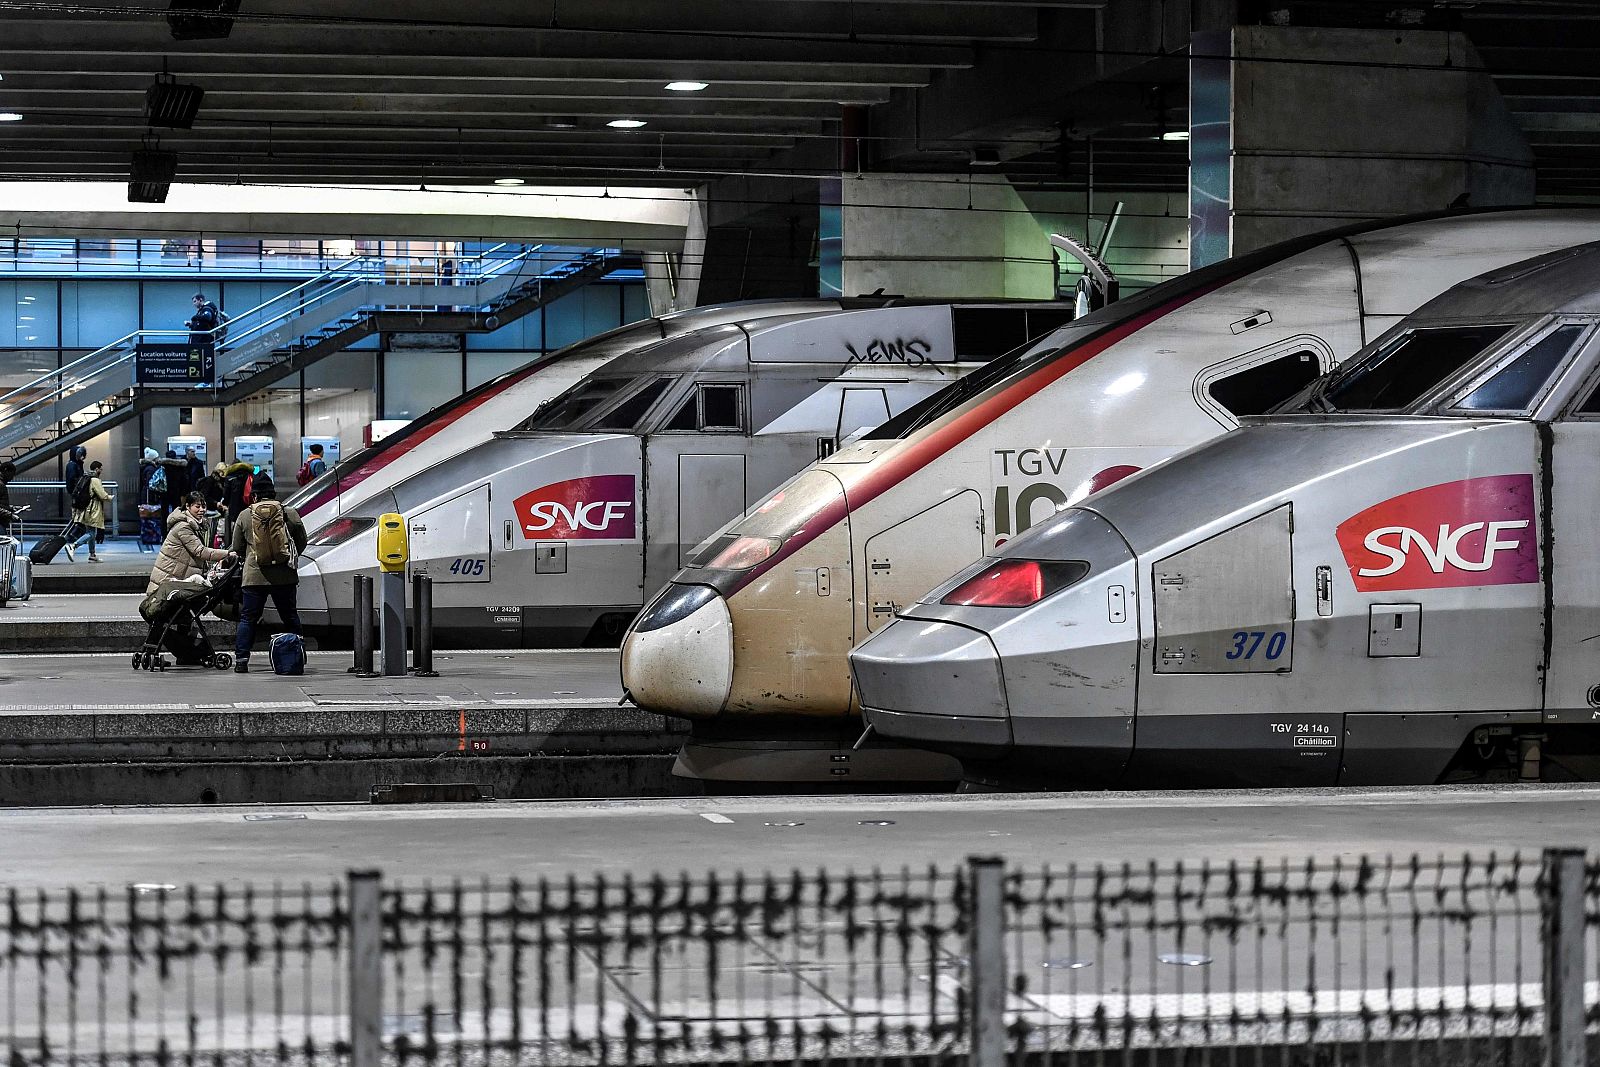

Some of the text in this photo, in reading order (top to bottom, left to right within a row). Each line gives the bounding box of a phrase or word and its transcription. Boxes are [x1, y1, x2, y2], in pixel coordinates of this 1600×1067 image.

[145, 367, 166, 375] Parking
[994, 448, 1068, 476] TGV
[525, 501, 632, 531] SNCF
[1357, 519, 1530, 577] SNCF
[449, 558, 486, 576] 405
[1226, 631, 1287, 660] 370
[1270, 723, 1292, 733] TGV
[1297, 737, 1333, 745] Châtillon
